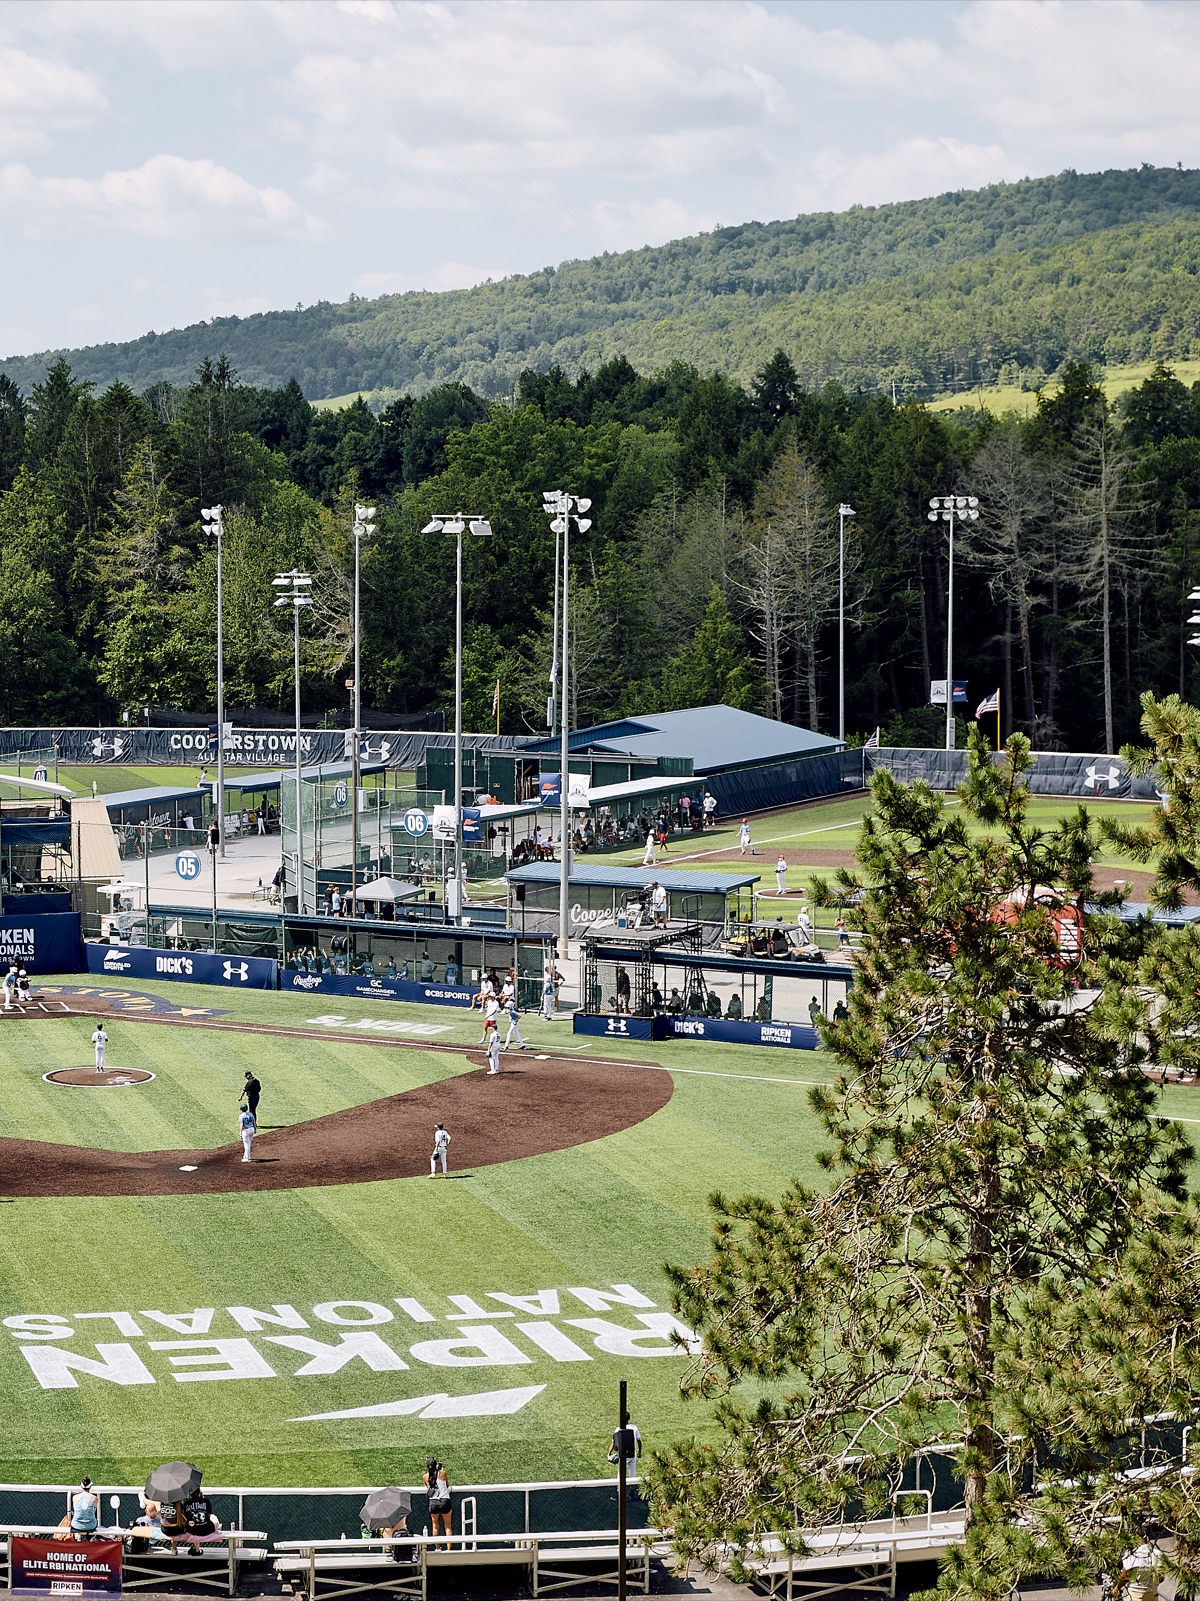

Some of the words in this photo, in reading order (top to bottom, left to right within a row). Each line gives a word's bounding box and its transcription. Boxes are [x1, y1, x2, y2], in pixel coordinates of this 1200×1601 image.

[171, 734, 311, 751] COORSTOWN
[197, 753, 215, 761] ALL
[223, 752, 242, 761] TAR
[246, 753, 286, 762] VILLAGE
[336, 788, 346, 803] 06
[407, 816, 424, 832] 06
[179, 857, 196, 876] 05
[156, 956, 193, 975] DICK'S
[293, 974, 323, 986] Rawlings
[431, 989, 444, 998] CBS
[444, 991, 470, 1000] SPORTS
[674, 1020, 705, 1035] DICK'S
[761, 1026, 792, 1038] RIPKEN
[761, 1035, 792, 1044] NATIONALS
[2, 1283, 658, 1340] NATIONALS
[19, 1312, 705, 1389] RIPKEN
[46, 1552, 74, 1562] HOME
[74, 1553, 87, 1562] OF
[22, 1560, 48, 1569] ELITE
[49, 1561, 65, 1570] RBI
[65, 1562, 112, 1573] NATIONAL
[52, 1582, 82, 1591] RIPKEN
